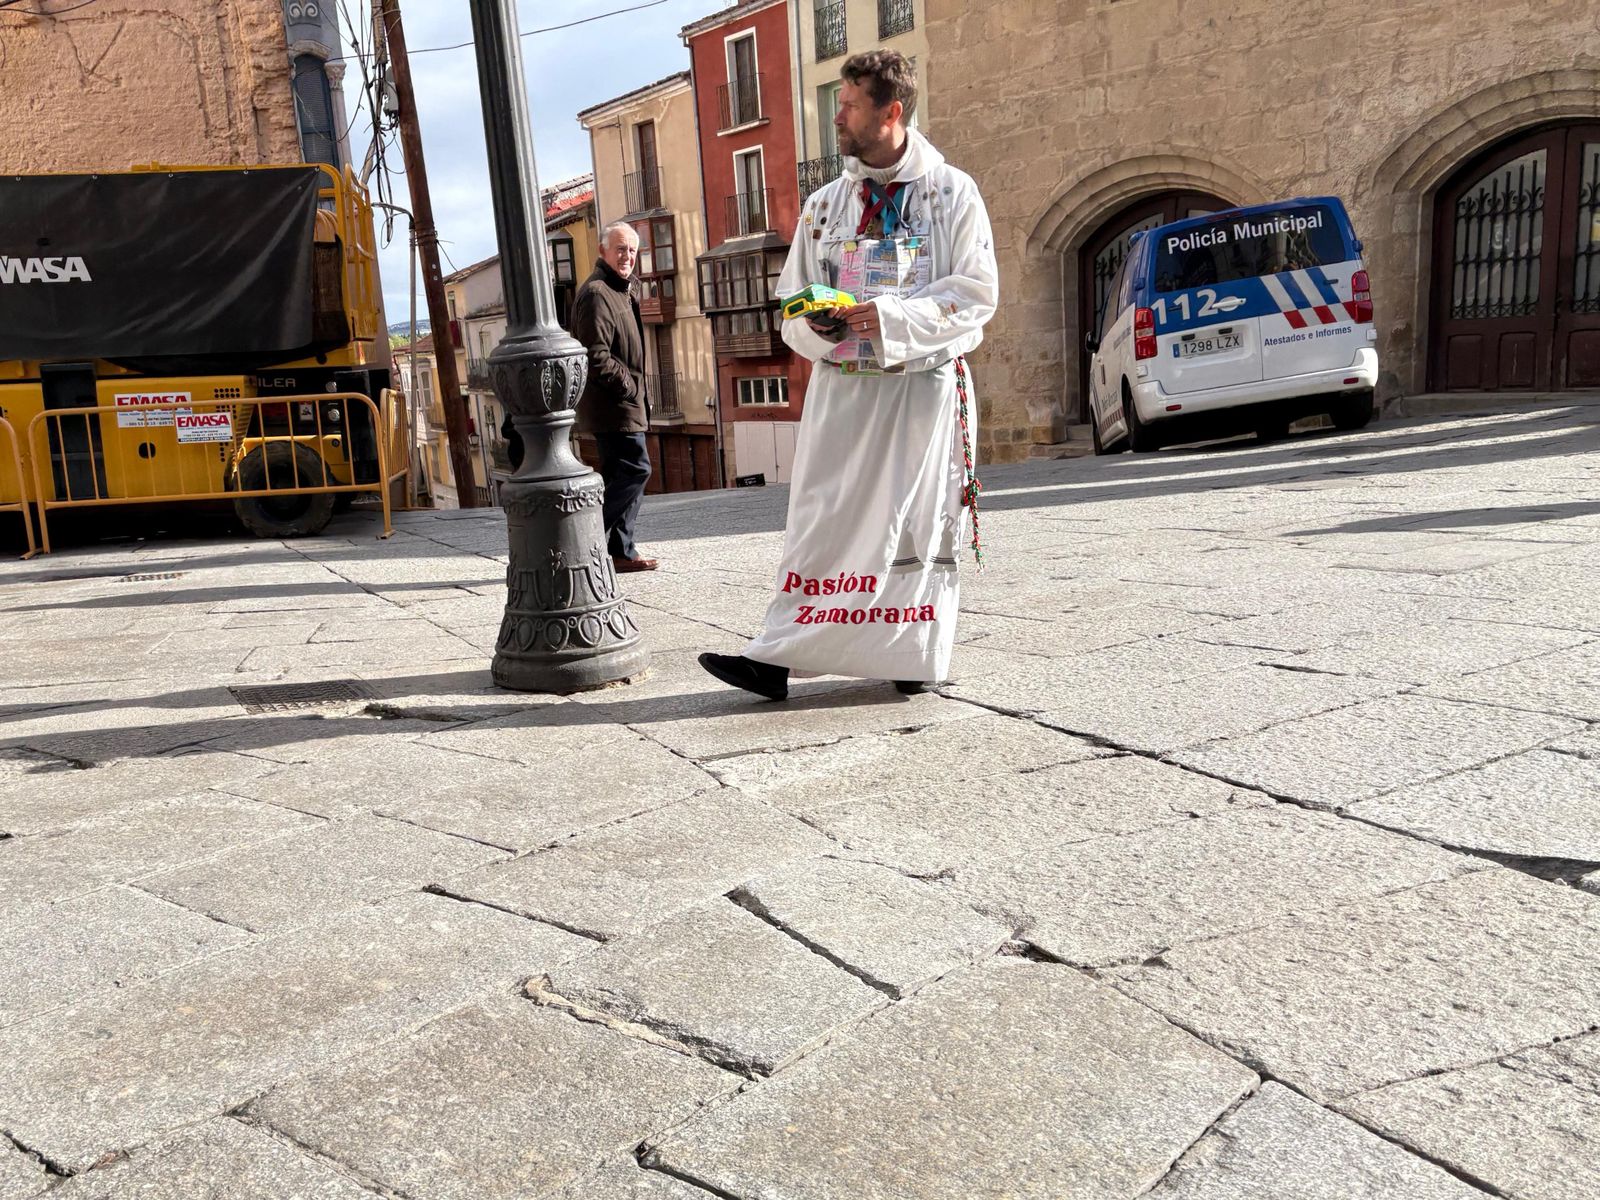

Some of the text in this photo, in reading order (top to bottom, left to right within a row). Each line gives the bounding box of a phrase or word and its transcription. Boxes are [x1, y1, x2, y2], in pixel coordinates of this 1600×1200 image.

[1167, 211, 1323, 255] Policía Municipal
[1151, 288, 1218, 325] 112
[1183, 339, 1213, 354] 1298
[1217, 335, 1240, 349] LZX
[1263, 331, 1306, 347] Atestados
[1315, 326, 1352, 339] Informes
[176, 414, 230, 428] EMASA
[781, 571, 877, 596] Pasión
[793, 604, 936, 625] Zamorana
